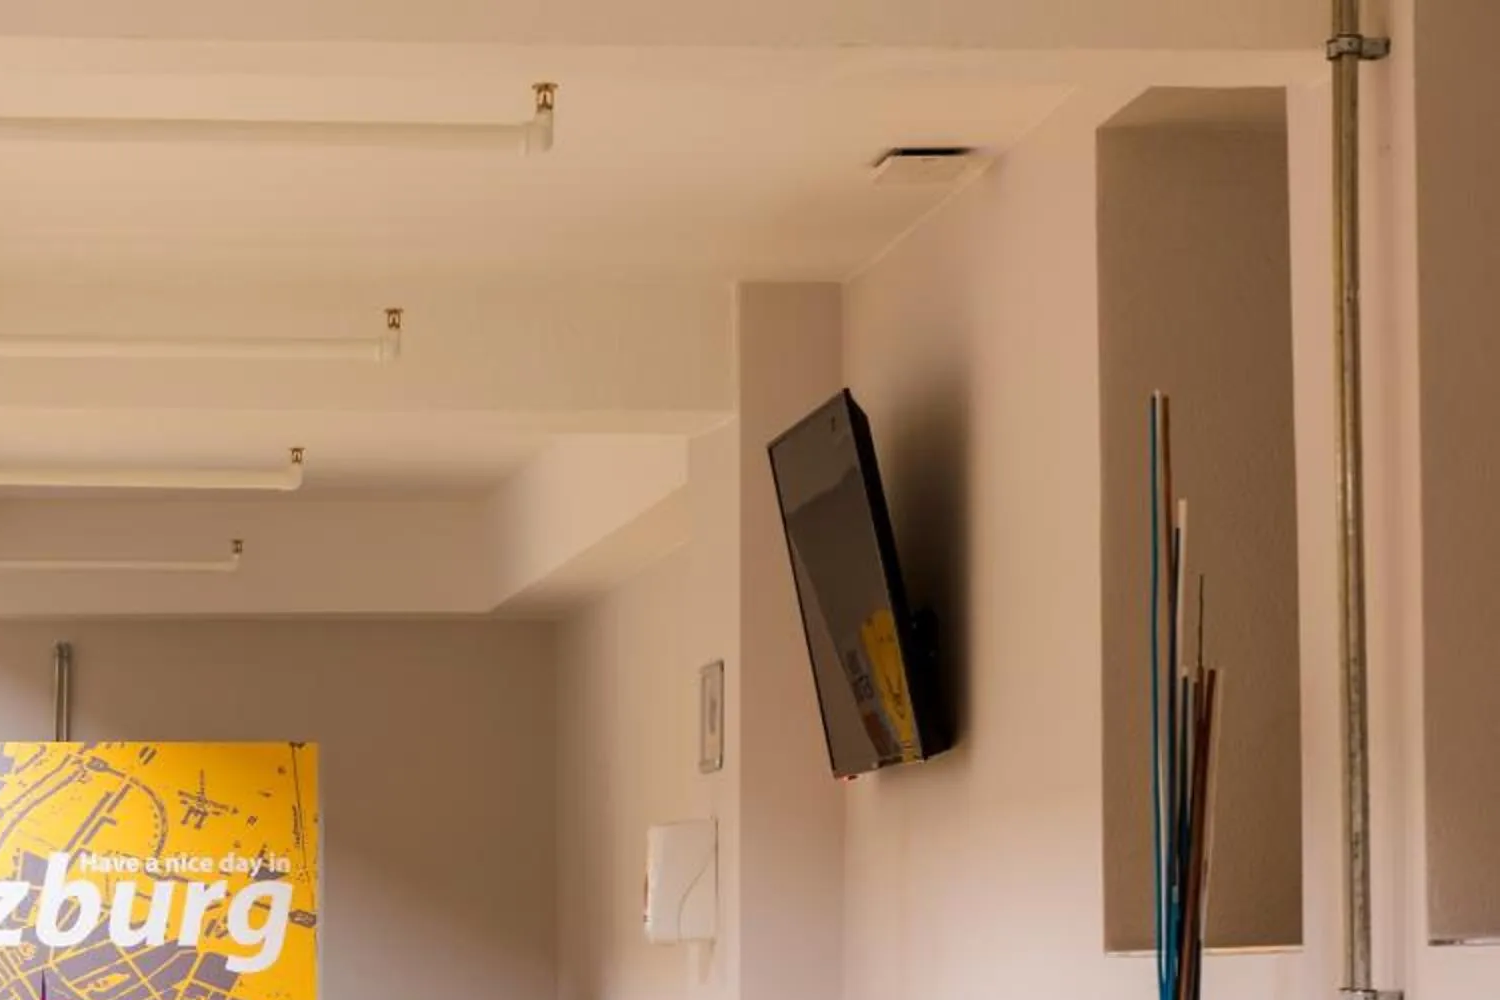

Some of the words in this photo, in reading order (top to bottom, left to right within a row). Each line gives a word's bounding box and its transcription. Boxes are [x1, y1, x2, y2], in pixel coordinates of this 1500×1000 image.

[78, 852, 139, 873] Have
[145, 858, 159, 873] a
[167, 853, 213, 873] nice
[218, 852, 261, 877] day
[269, 853, 292, 873] in
